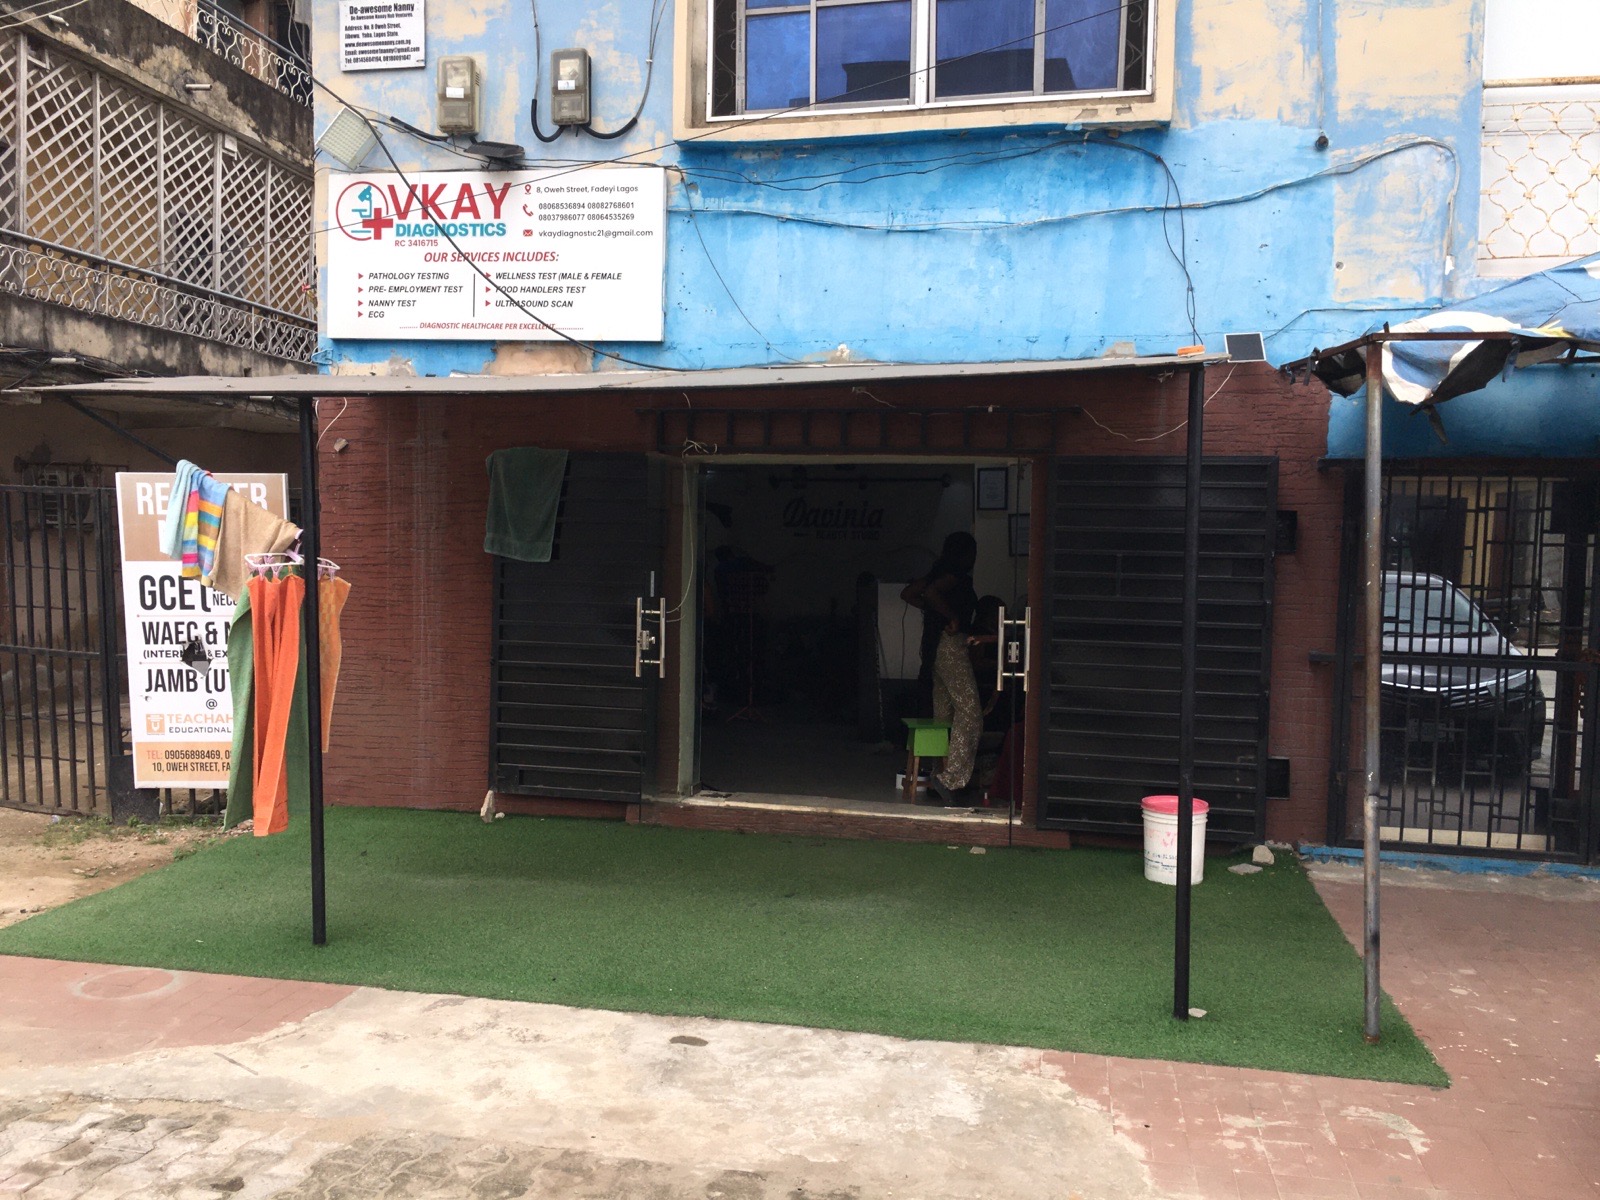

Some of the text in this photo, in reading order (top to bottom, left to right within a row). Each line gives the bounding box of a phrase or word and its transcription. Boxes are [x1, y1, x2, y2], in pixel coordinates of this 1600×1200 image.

[349, 3, 414, 14] De-awesome Nanny
[536, 186, 542, 194] 8,
[566, 186, 589, 194] Street,
[591, 185, 616, 193] Fadeyi
[617, 186, 638, 194] Lagos
[388, 182, 512, 220] VKAY
[538, 202, 585, 210] 08068536894
[396, 223, 506, 237] DIAGNOSTICS
[538, 229, 653, 238] vkaydiagnostic21@gmail.com
[424, 251, 560, 262] OUR SERVICES INCLUDES:
[368, 272, 450, 280] PATHOLOGY TESTING
[495, 272, 536, 280] WELLNESS
[538, 272, 557, 280] TEST
[558, 272, 582, 281] (MALE
[584, 272, 589, 280] &
[551, 300, 574, 308] SCAN
[816, 530, 848, 540] BEAUTY
[139, 574, 195, 611] GCE
[142, 621, 198, 645] WAEC
[205, 621, 218, 645] &
[145, 669, 198, 692] JAMB
[146, 750, 162, 760] TEL:
[152, 762, 164, 772] 10,
[166, 762, 188, 771] OWEH
[190, 762, 220, 772] STREET,
